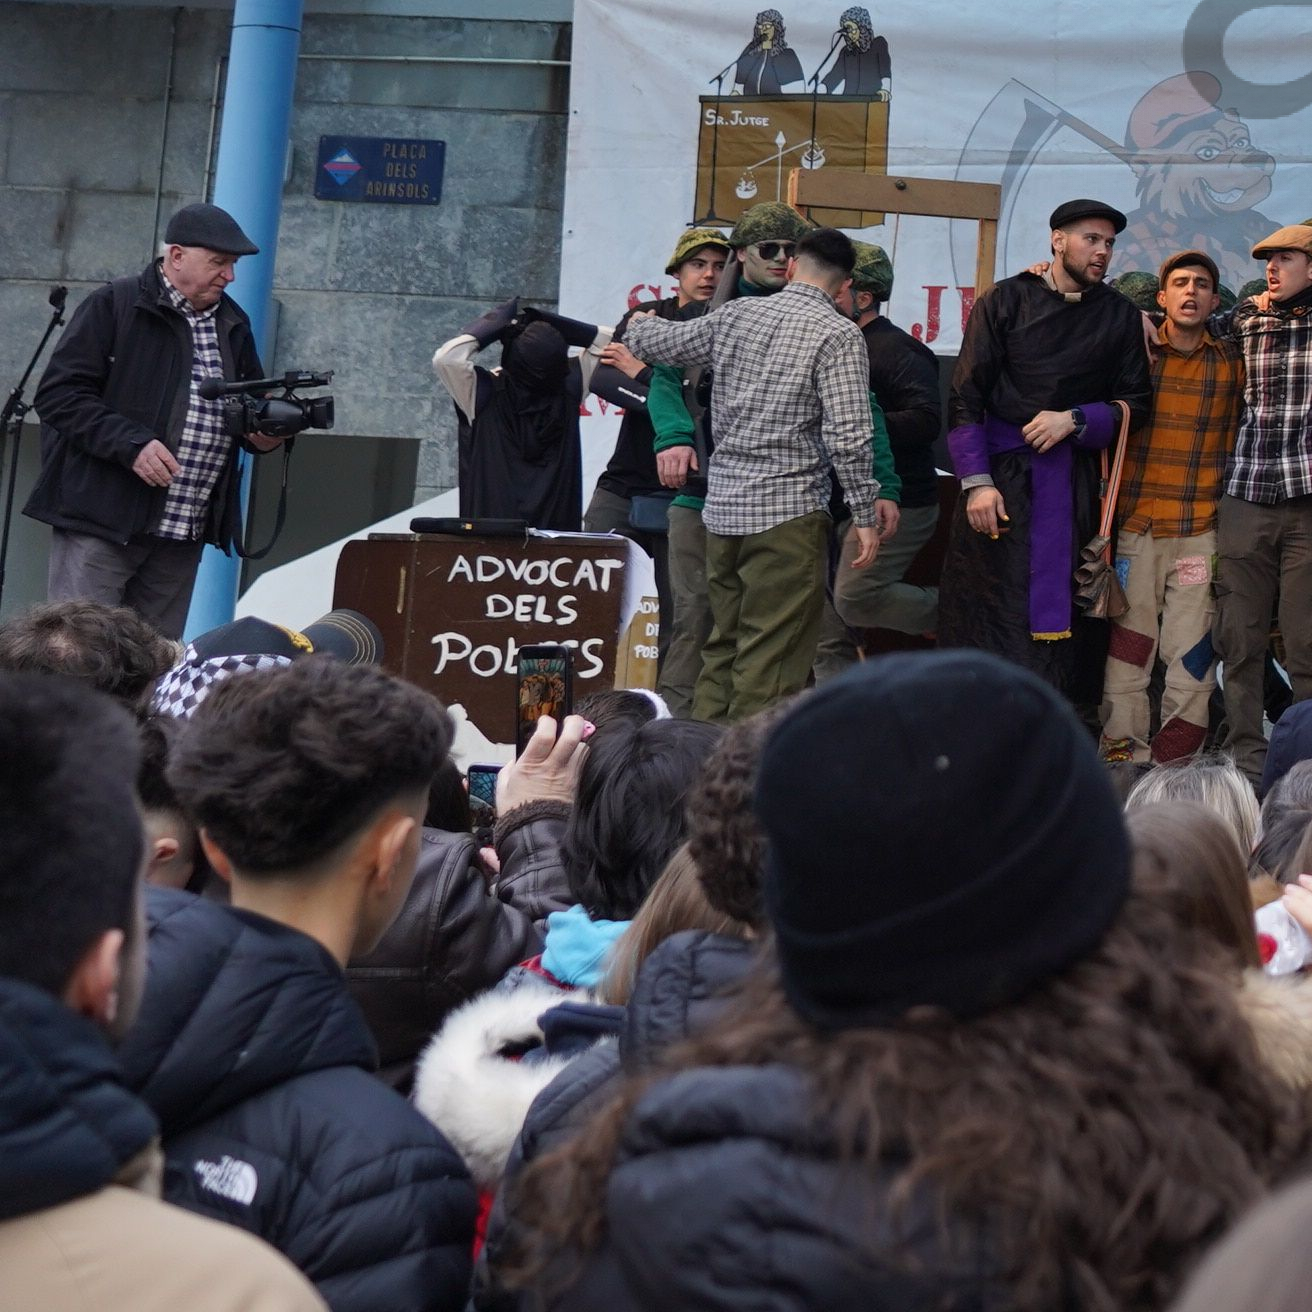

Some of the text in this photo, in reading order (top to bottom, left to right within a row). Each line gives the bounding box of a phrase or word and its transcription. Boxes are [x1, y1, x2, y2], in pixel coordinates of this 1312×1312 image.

[386, 162, 417, 178] DELS
[367, 181, 429, 199] ARINSOLS
[447, 554, 625, 592] ADVOCAT
[485, 594, 578, 625] DELS
